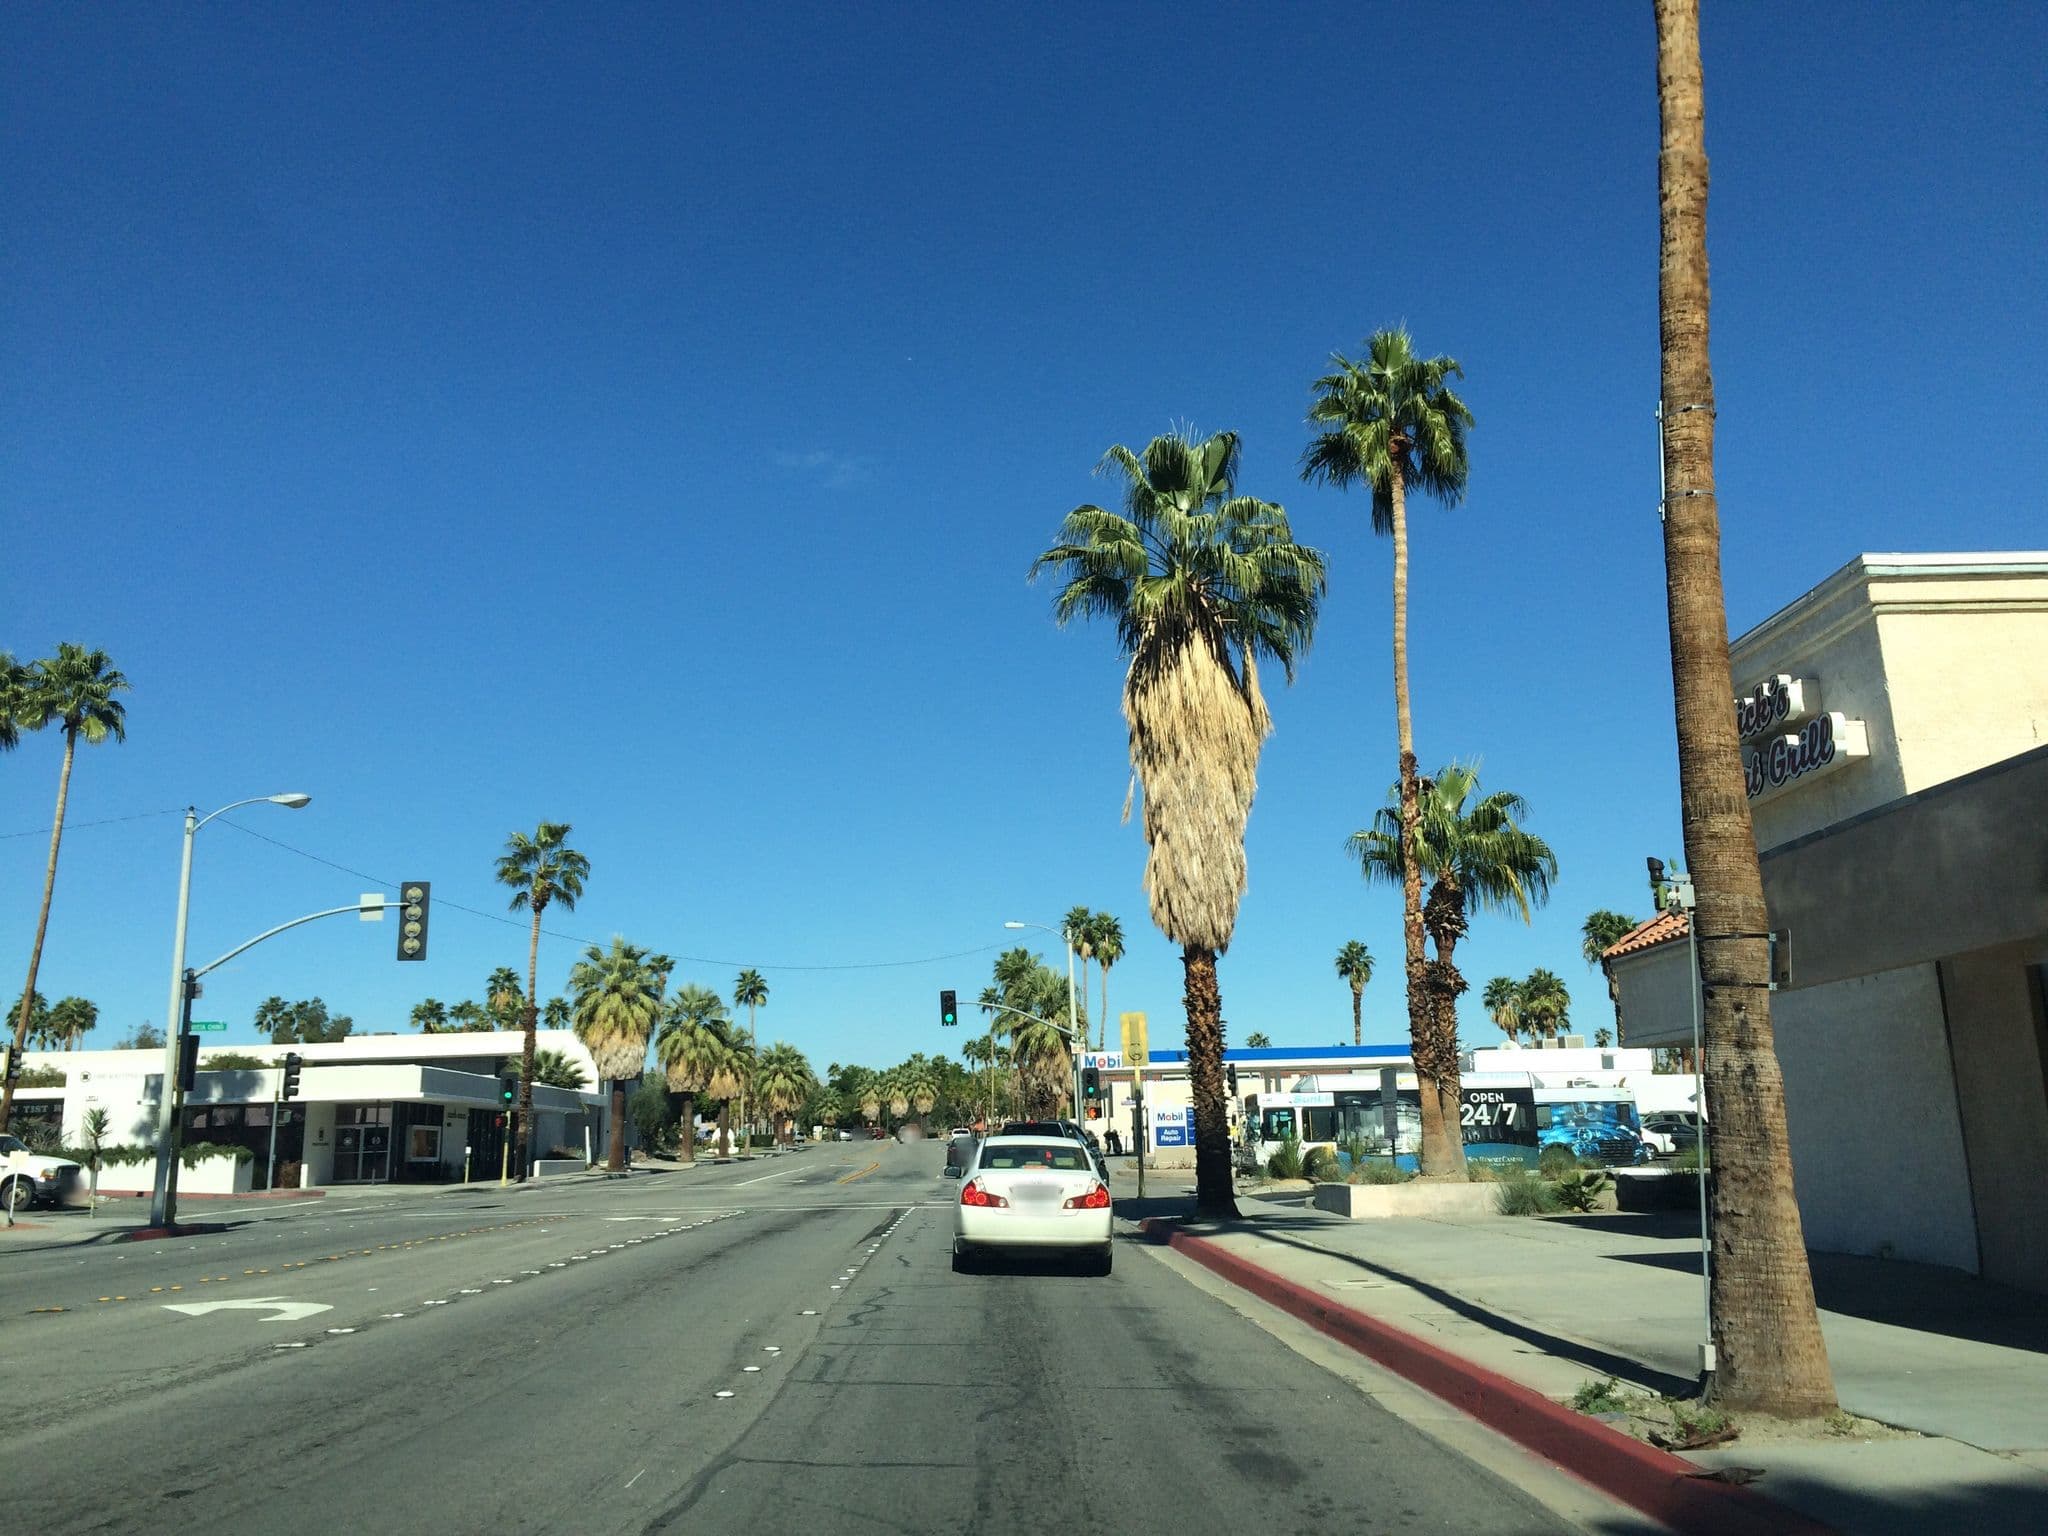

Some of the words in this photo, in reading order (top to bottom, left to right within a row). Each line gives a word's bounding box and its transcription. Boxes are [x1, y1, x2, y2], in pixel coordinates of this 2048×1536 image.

[1736, 674, 1790, 739] ick's
[1767, 712, 1835, 787] Grill
[1084, 1055, 1121, 1068] Mobi
[1469, 1092, 1505, 1103] OPEN
[1157, 1112, 1183, 1121] Mobil
[1459, 1103, 1517, 1126] 24/7
[1160, 1135, 1182, 1143] Repair
